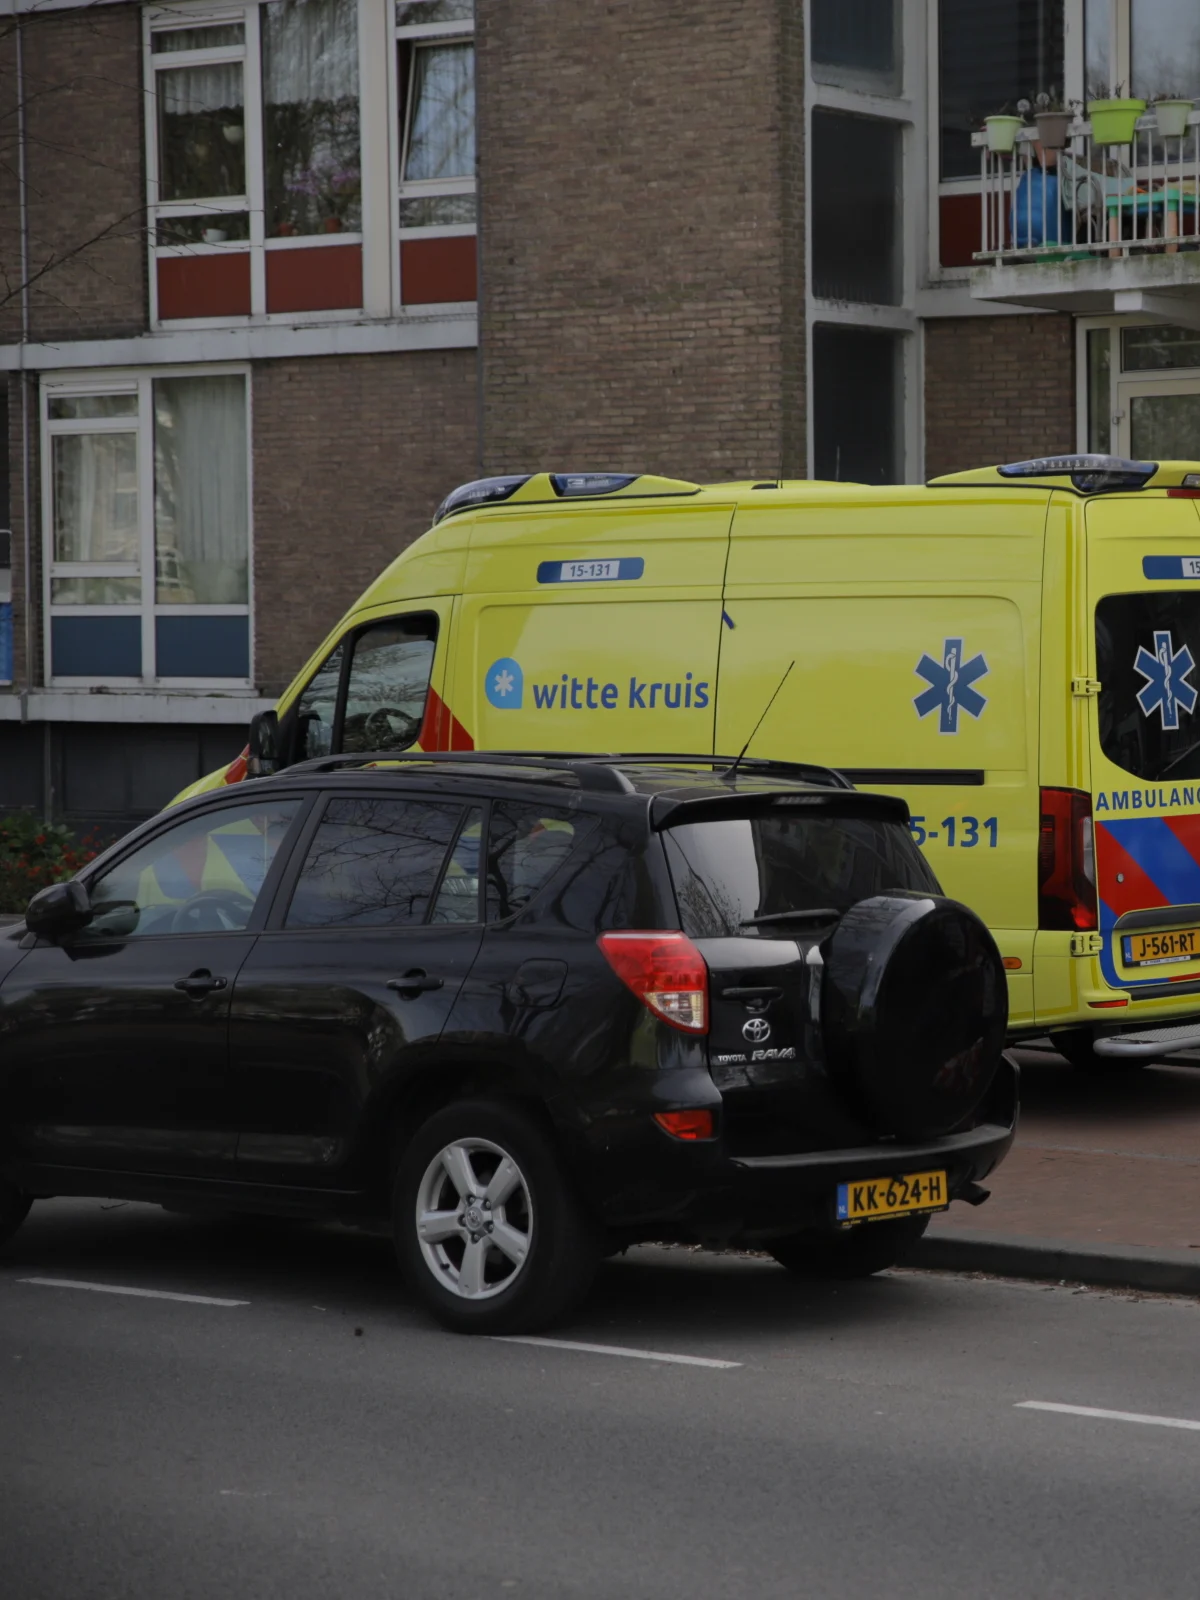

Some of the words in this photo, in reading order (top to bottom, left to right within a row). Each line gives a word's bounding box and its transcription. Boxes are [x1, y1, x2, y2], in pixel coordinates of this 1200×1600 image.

[569, 563, 612, 578] 15-131
[532, 673, 619, 710] witte
[628, 671, 710, 709] kruis
[909, 816, 998, 848] 5-131
[1139, 932, 1196, 958] J-561-RT
[718, 1054, 748, 1062] TOYOTA
[751, 1047, 796, 1061] RAV4
[853, 1176, 941, 1213] KK-624-H
